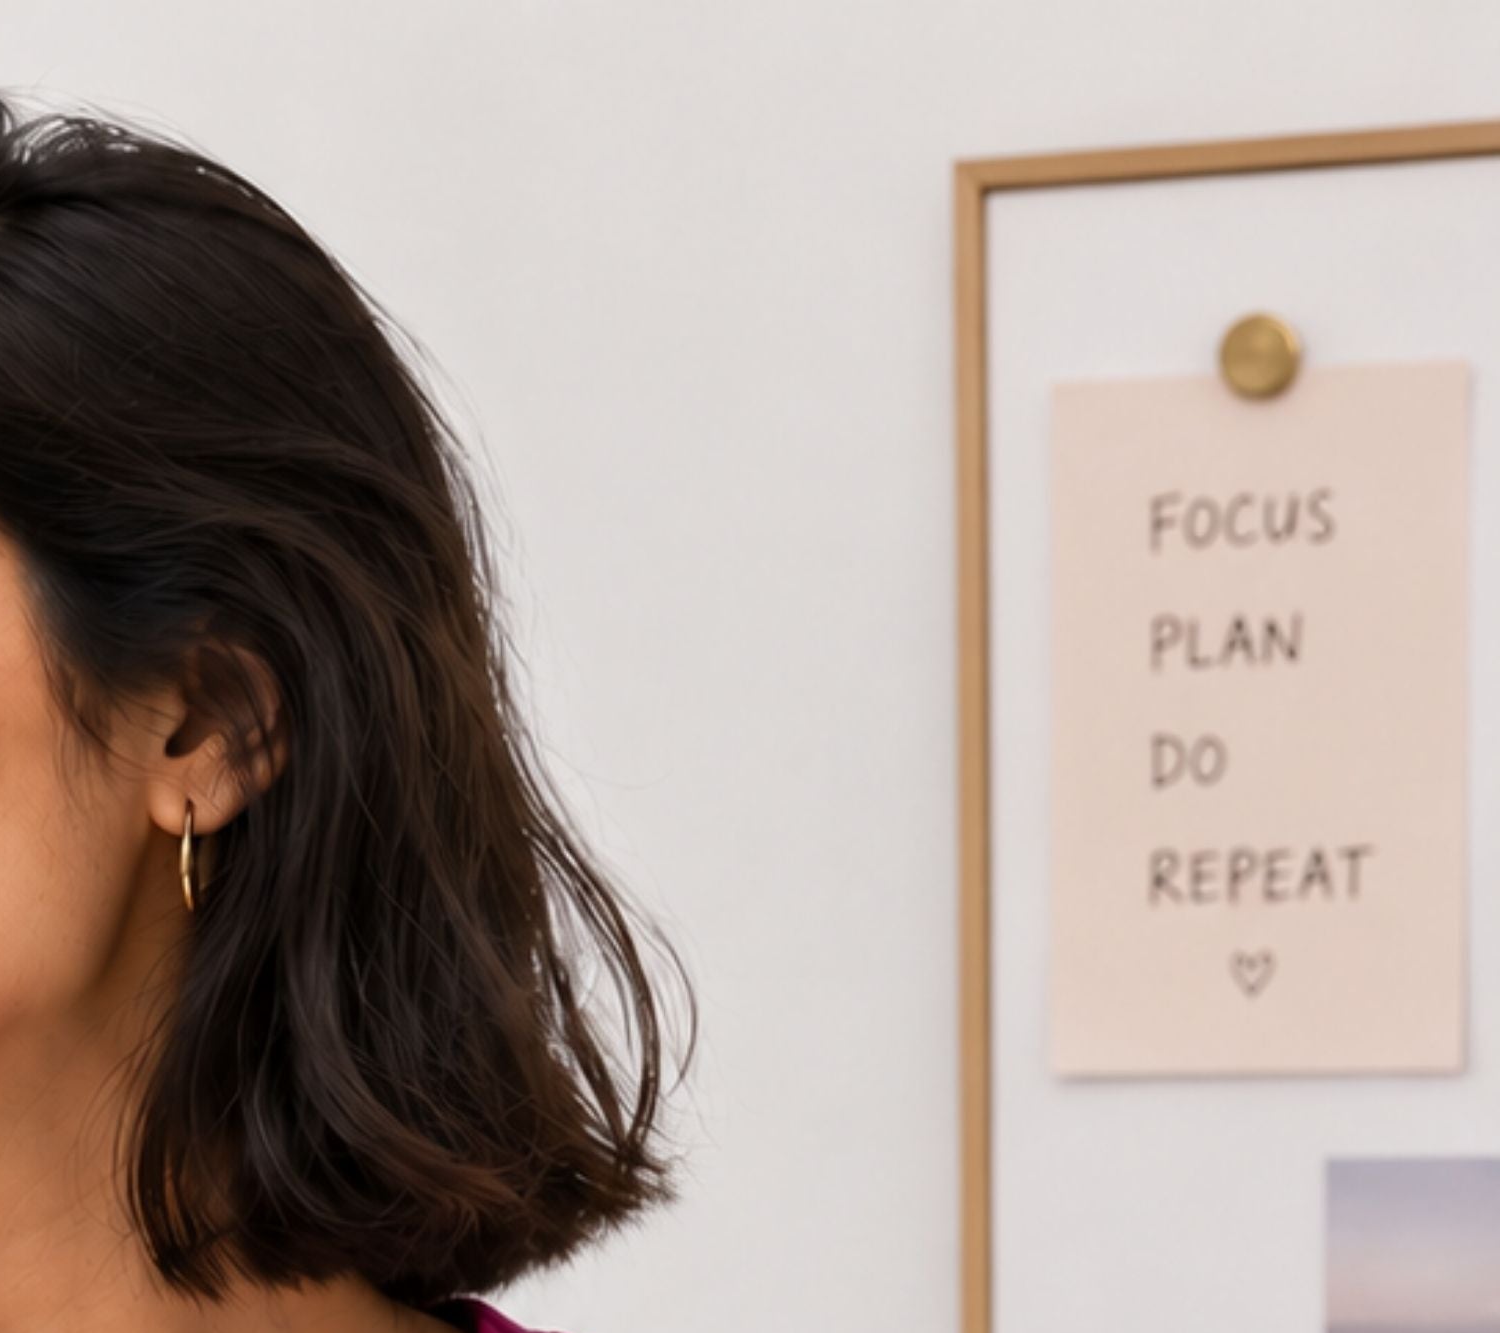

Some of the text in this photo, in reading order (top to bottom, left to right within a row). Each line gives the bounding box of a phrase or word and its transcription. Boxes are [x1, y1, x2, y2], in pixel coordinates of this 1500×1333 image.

[1147, 485, 1338, 554] FOCUS
[1149, 612, 1305, 672] PLAN
[1148, 729, 1230, 793] DO
[1146, 843, 1373, 906] REPEAT
